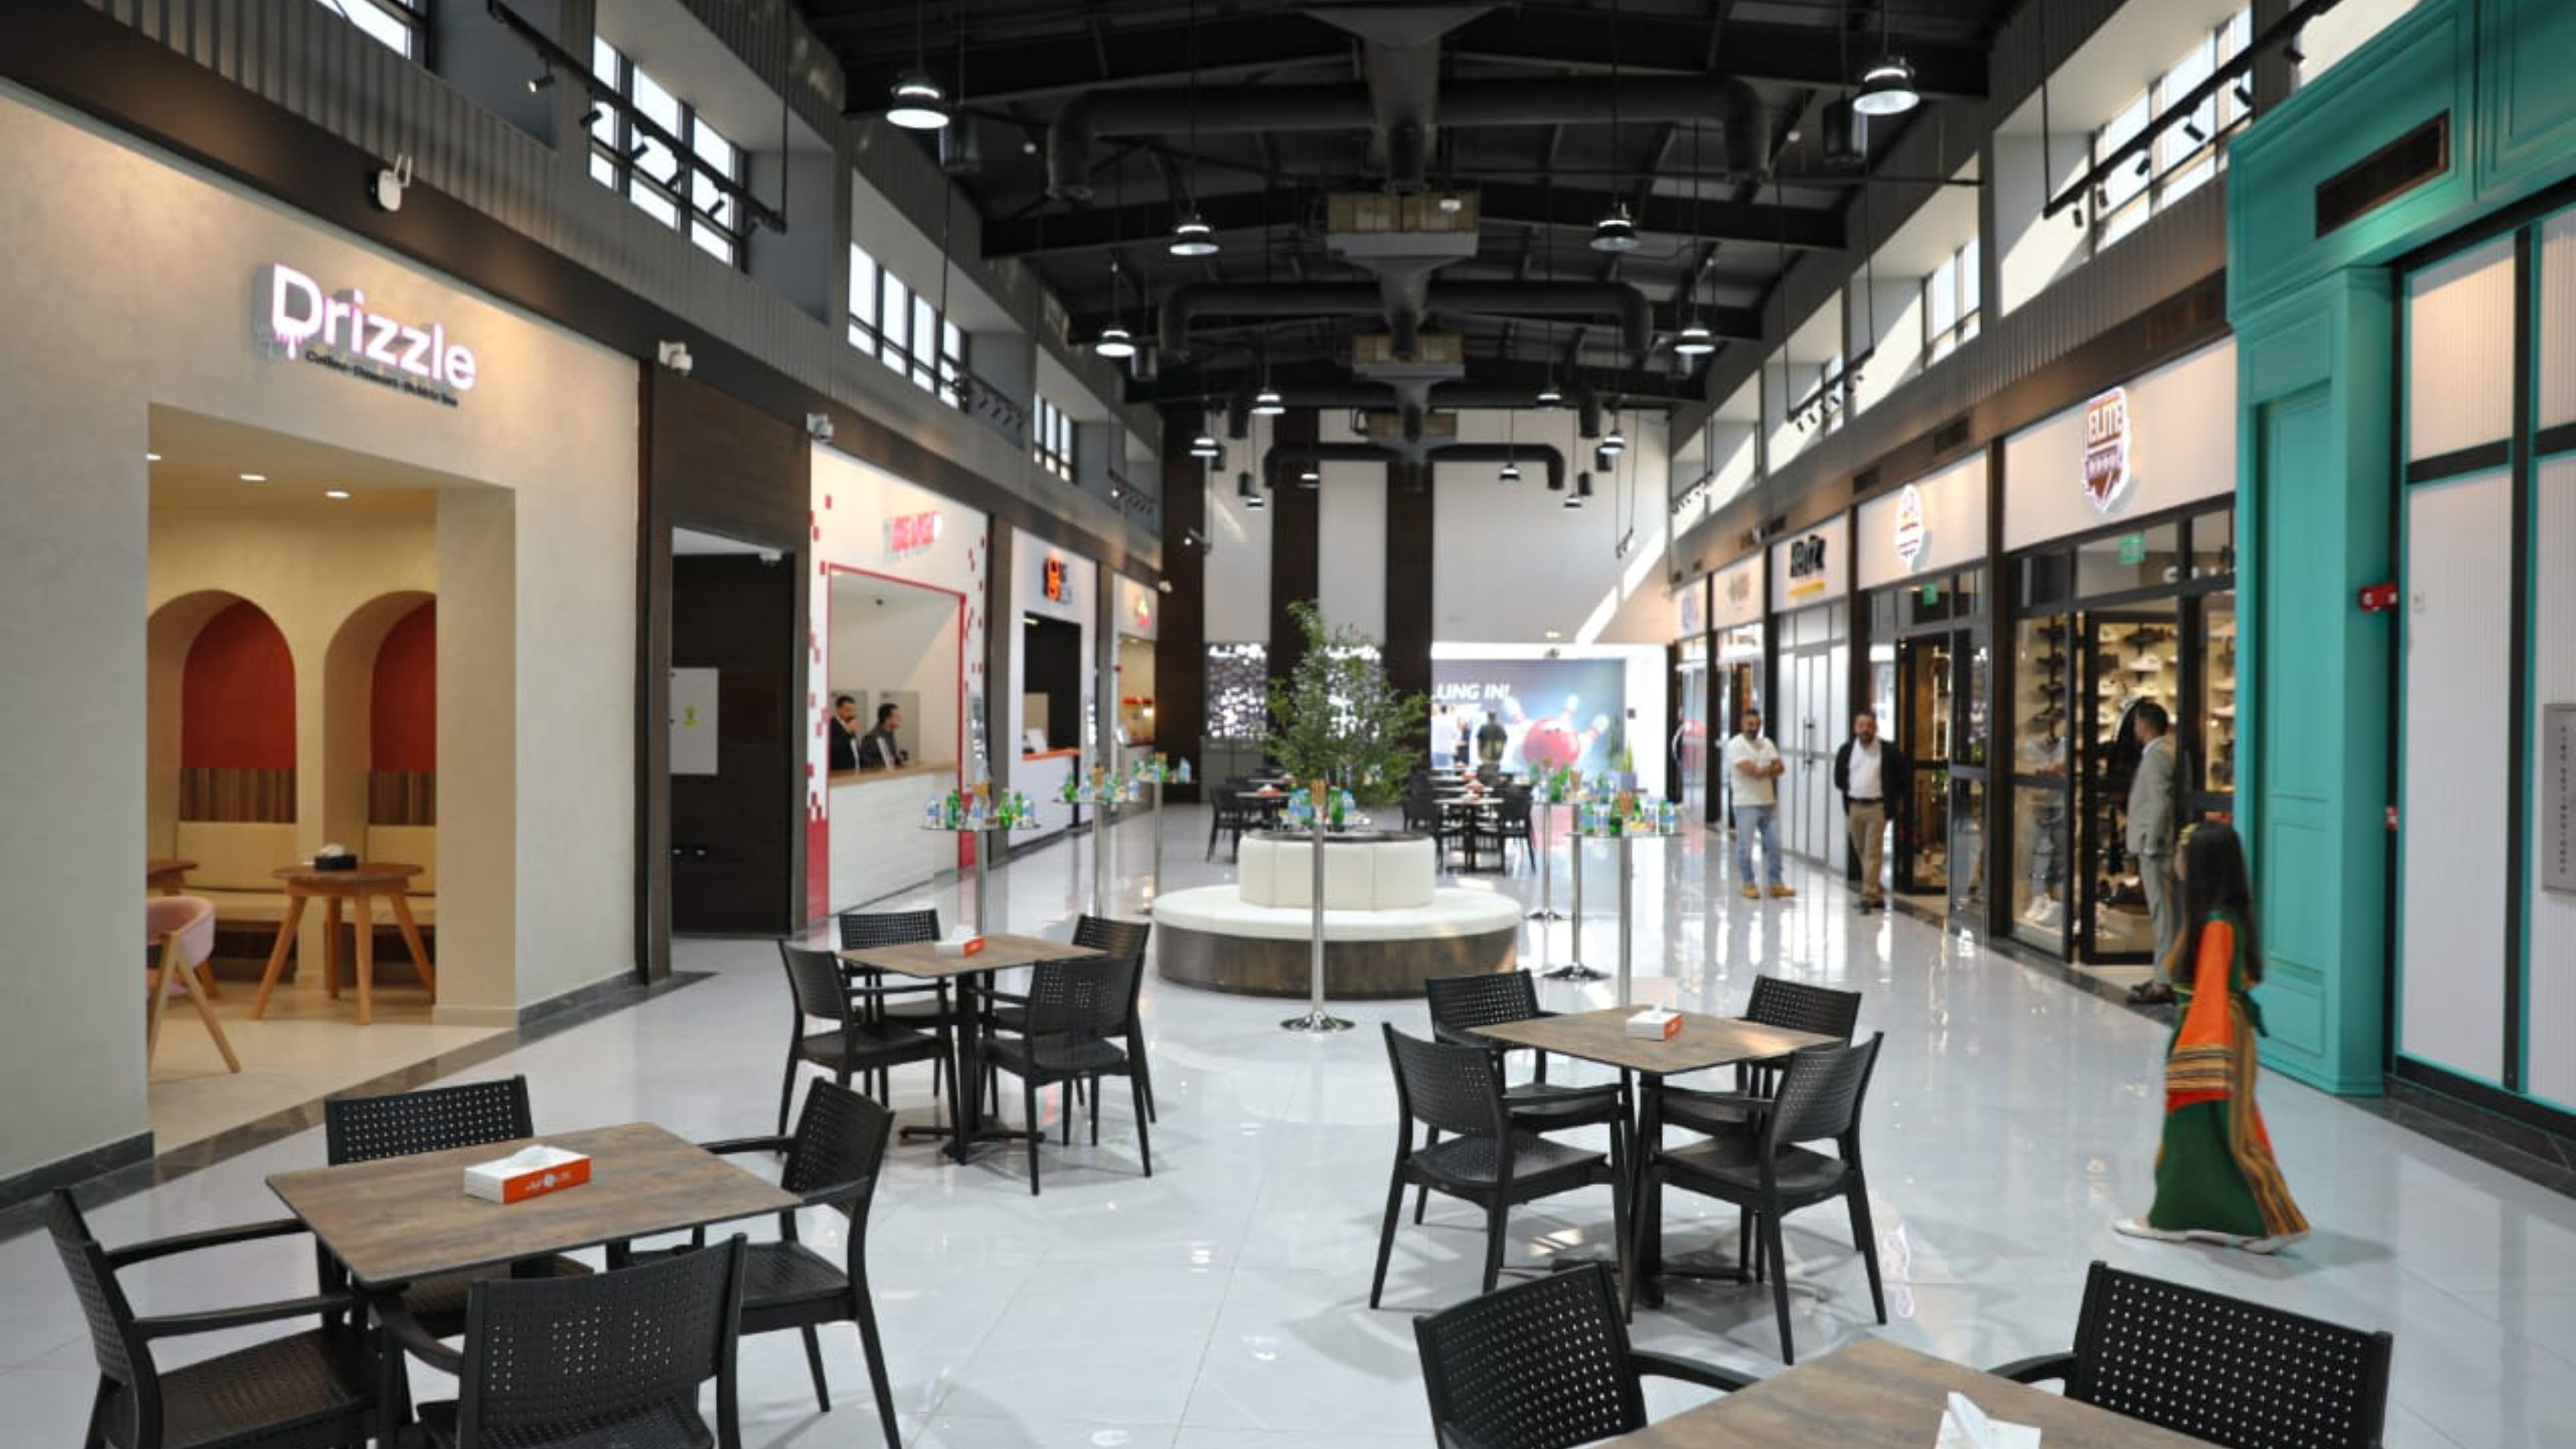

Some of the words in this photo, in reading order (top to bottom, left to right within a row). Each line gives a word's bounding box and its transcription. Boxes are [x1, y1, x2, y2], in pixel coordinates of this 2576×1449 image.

[271, 263, 475, 390] Drizzle
[2088, 401, 2123, 444] ELITE
[1431, 683, 1480, 700] LING
